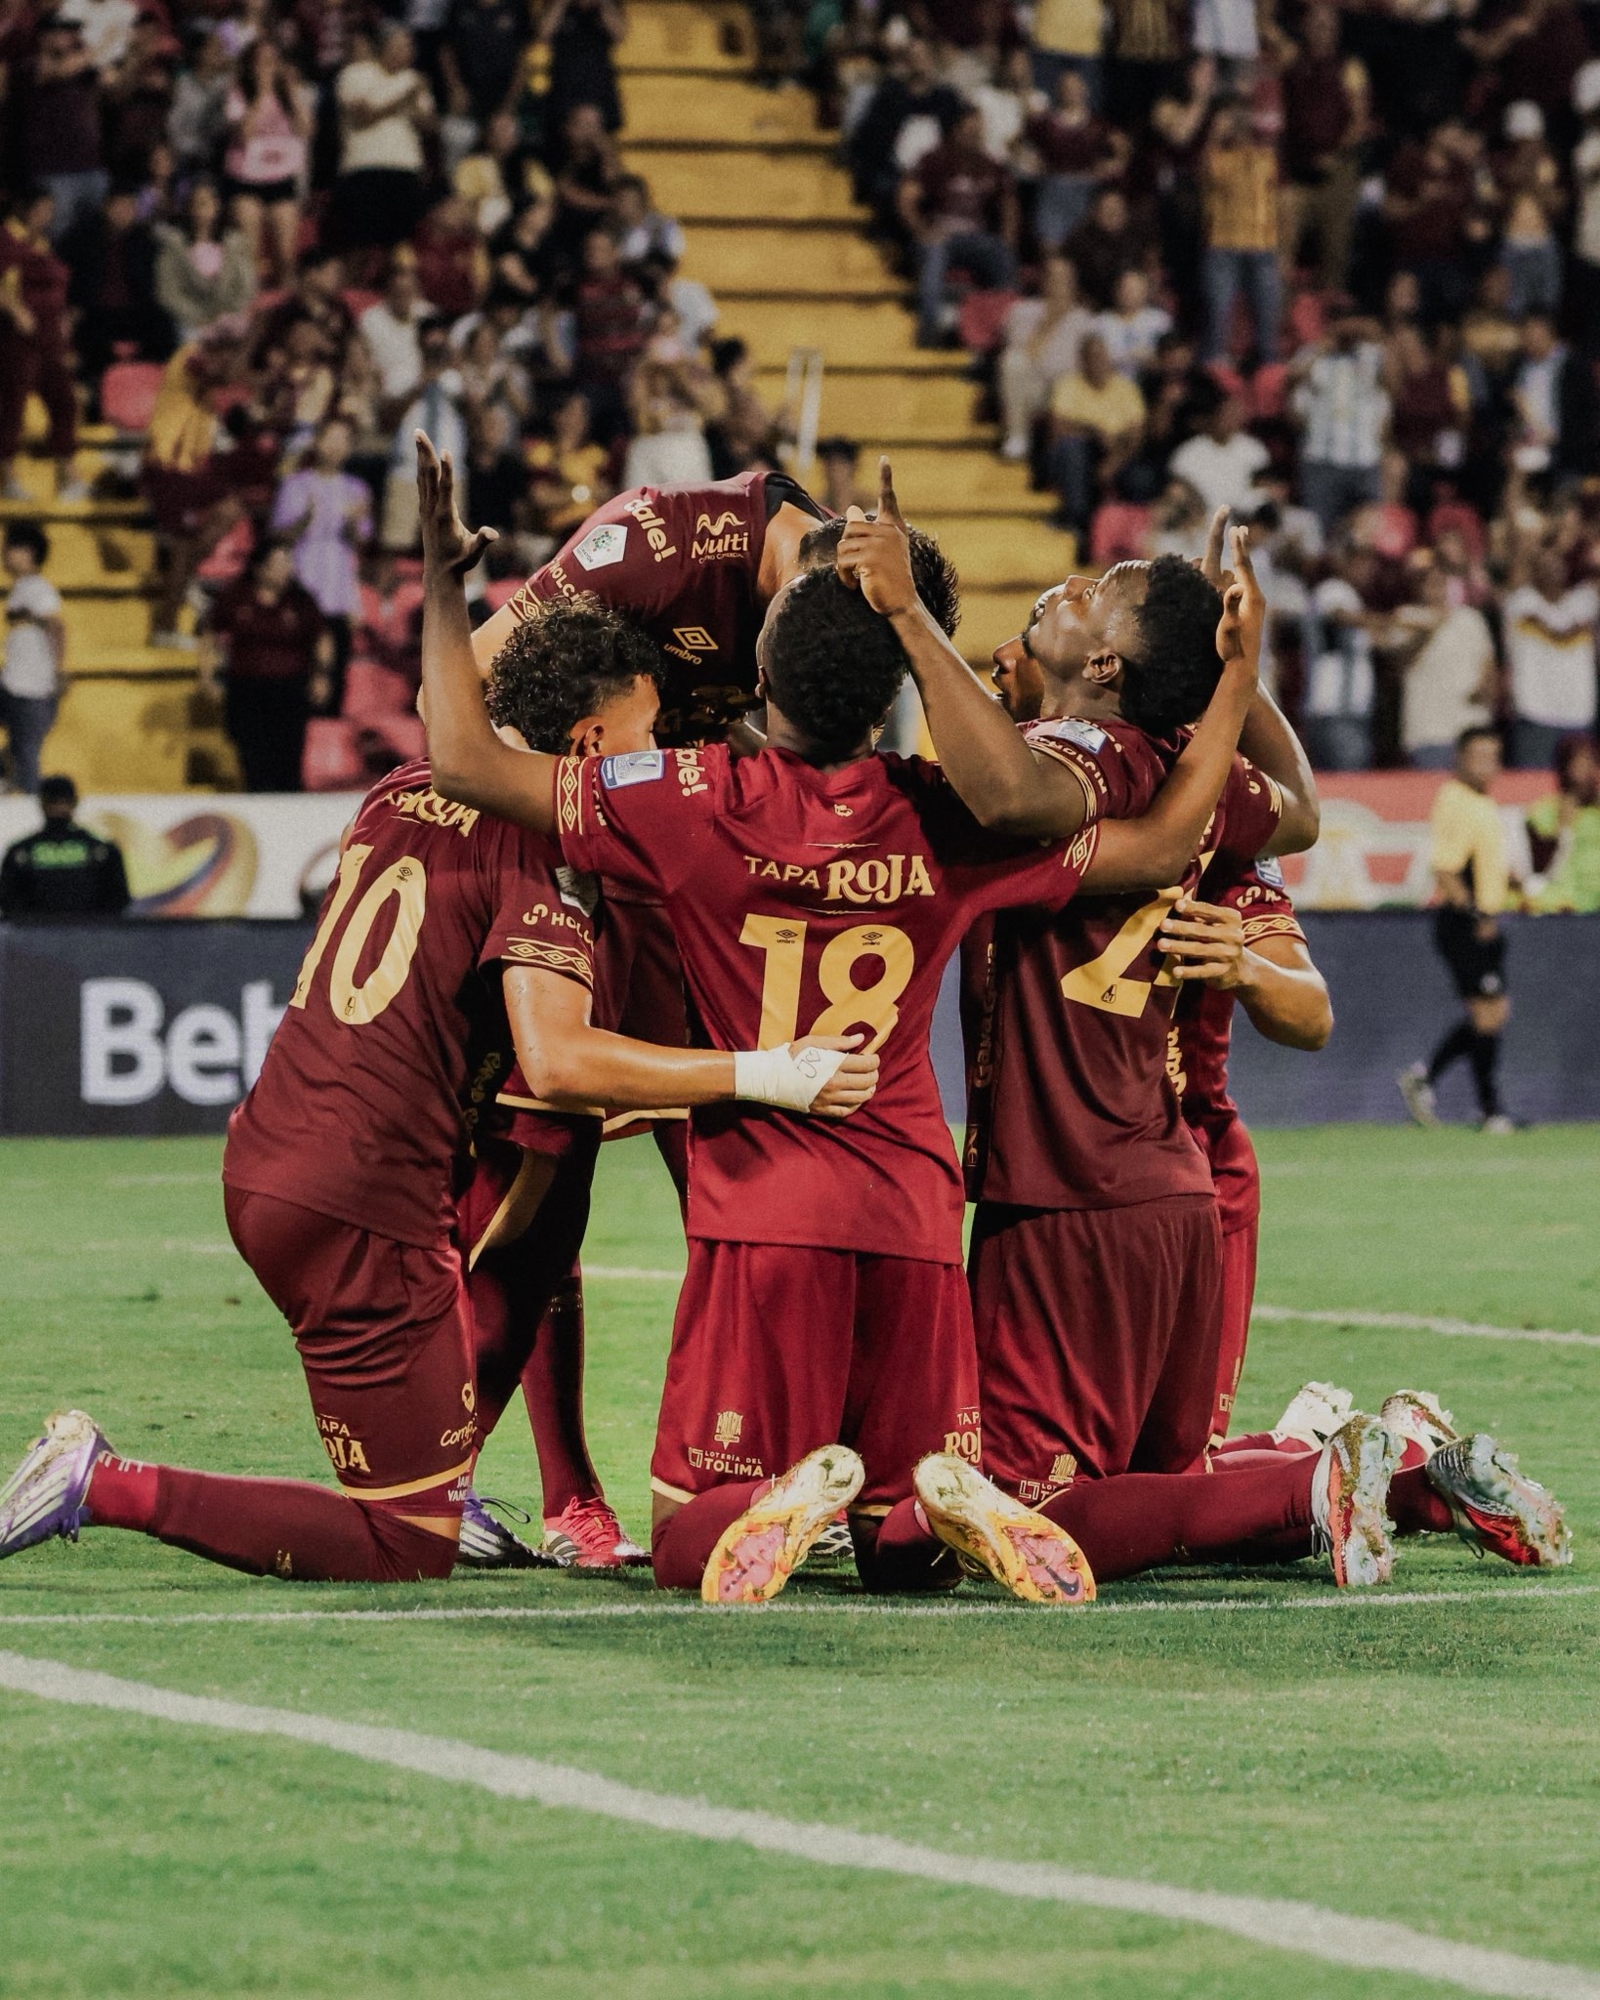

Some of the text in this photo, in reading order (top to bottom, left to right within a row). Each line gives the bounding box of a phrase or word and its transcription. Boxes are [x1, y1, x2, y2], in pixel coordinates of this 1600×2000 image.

[691, 532, 749, 559] Multi
[664, 643, 702, 665] umbro
[743, 854, 936, 904] TAPA ROJA
[289, 843, 427, 1025] 10
[738, 913, 915, 1056] 18
[957, 1411, 980, 1426] TAP
[323, 1436, 371, 1473] OJA
[943, 1427, 981, 1464] ROJ
[704, 1458, 764, 1477] TOLIMA
